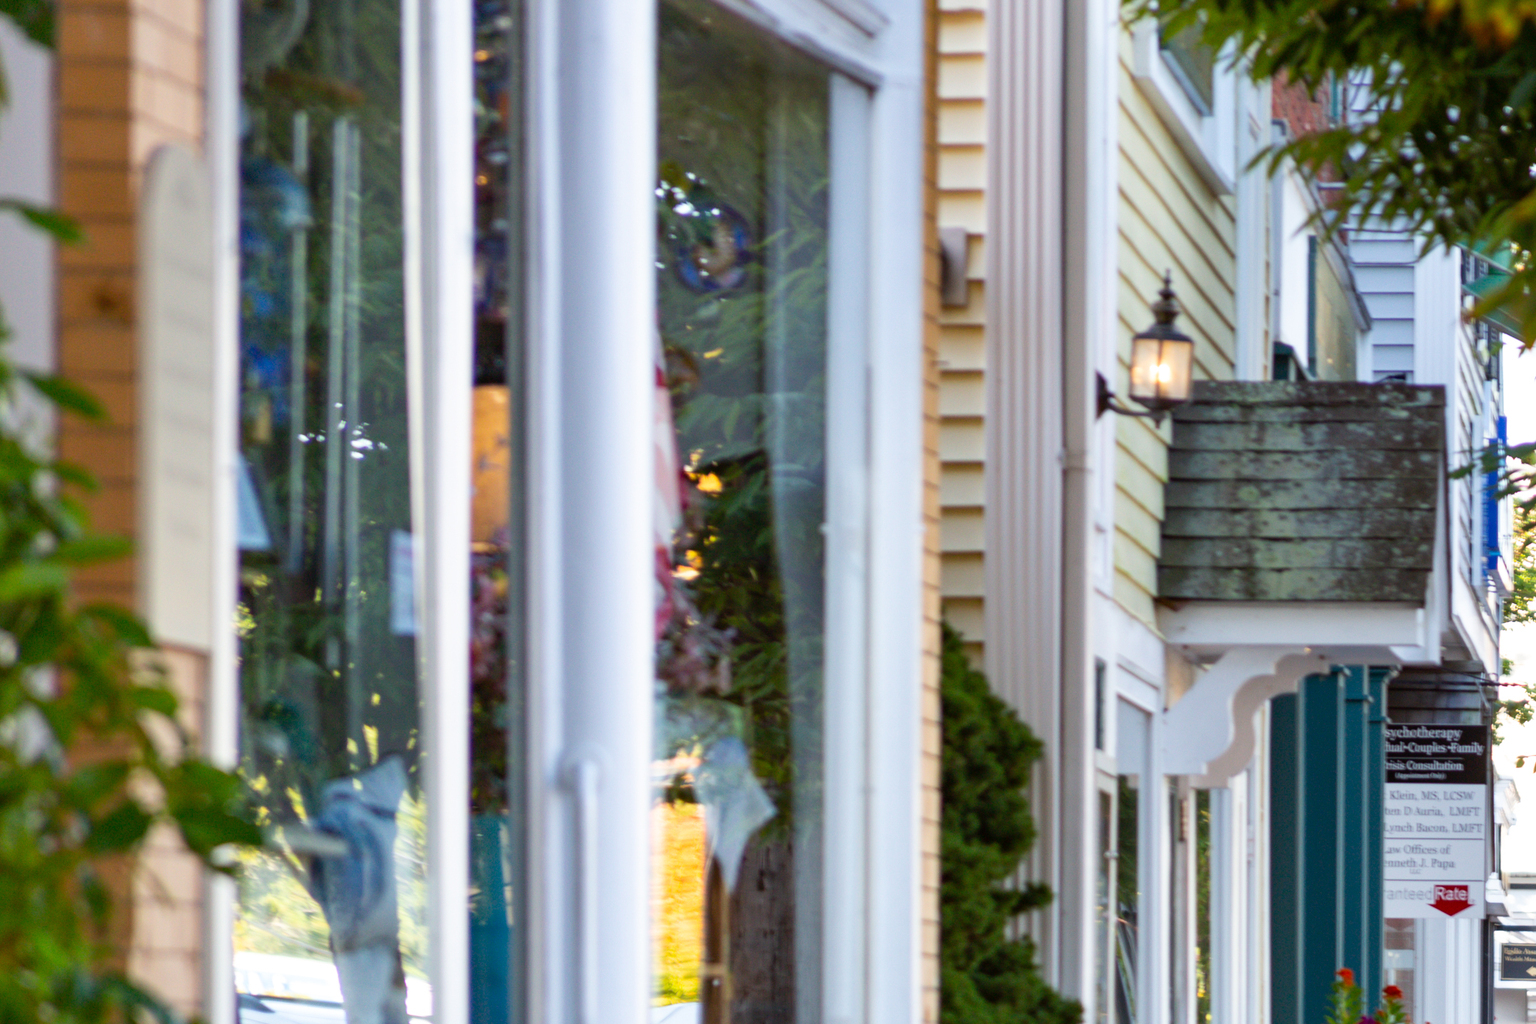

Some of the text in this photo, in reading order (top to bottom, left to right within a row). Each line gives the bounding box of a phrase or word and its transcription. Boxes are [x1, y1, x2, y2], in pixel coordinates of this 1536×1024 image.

[1384, 725, 1463, 741] sychotherapy
[1384, 760, 1464, 770] risis Consultation
[1389, 790, 1475, 801] Klein, MS, LCSW
[1449, 806, 1481, 817] LMFT
[1416, 822, 1449, 833] Bacon,
[1452, 823, 1484, 833] LMFT
[1403, 844, 1437, 854] Offices
[1440, 844, 1452, 855] of
[1383, 858, 1416, 868] enneth
[1430, 859, 1456, 871] Papa
[1435, 886, 1468, 901] Rate
